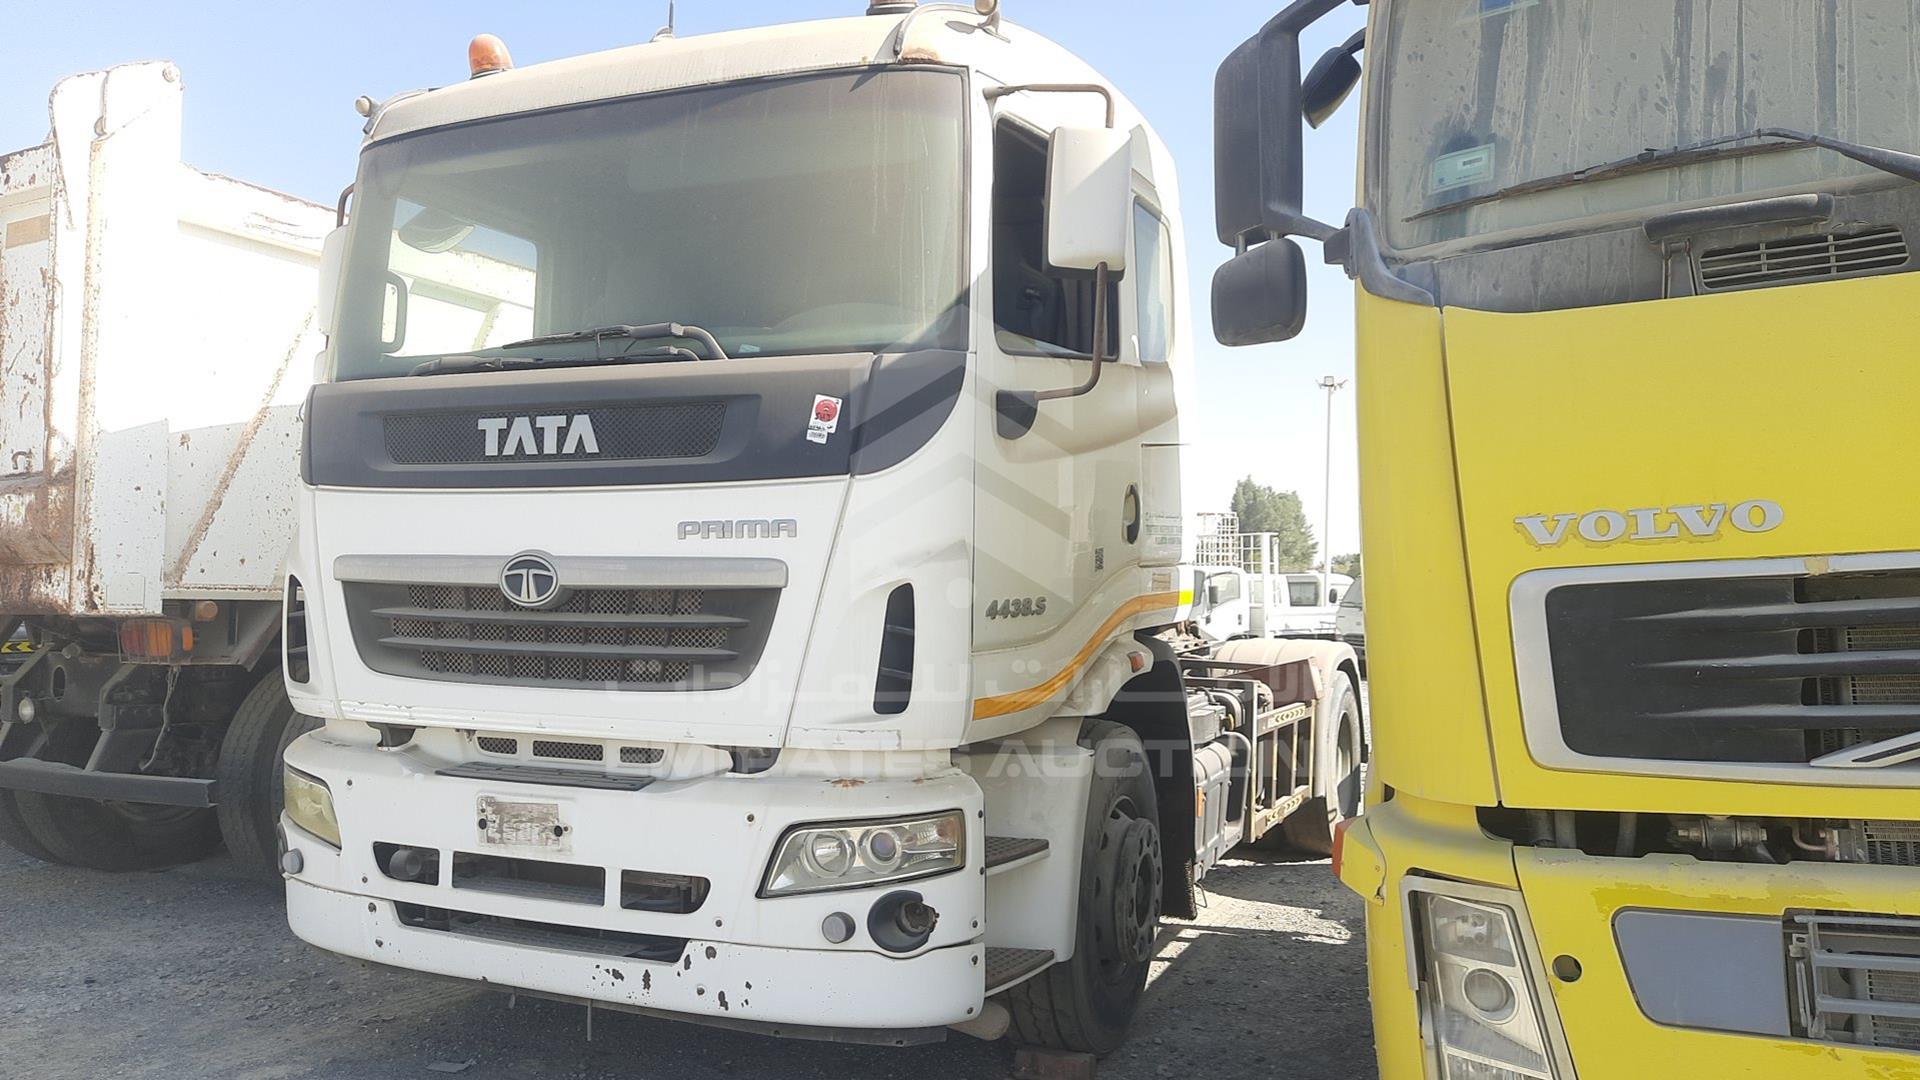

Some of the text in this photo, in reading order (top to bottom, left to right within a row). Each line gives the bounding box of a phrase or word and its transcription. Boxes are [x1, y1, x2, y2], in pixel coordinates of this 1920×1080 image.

[477, 414, 600, 456] TATA
[677, 518, 797, 540] PRIMA
[1514, 499, 1785, 545] VOLVO
[985, 596, 1047, 620] 4438.S
